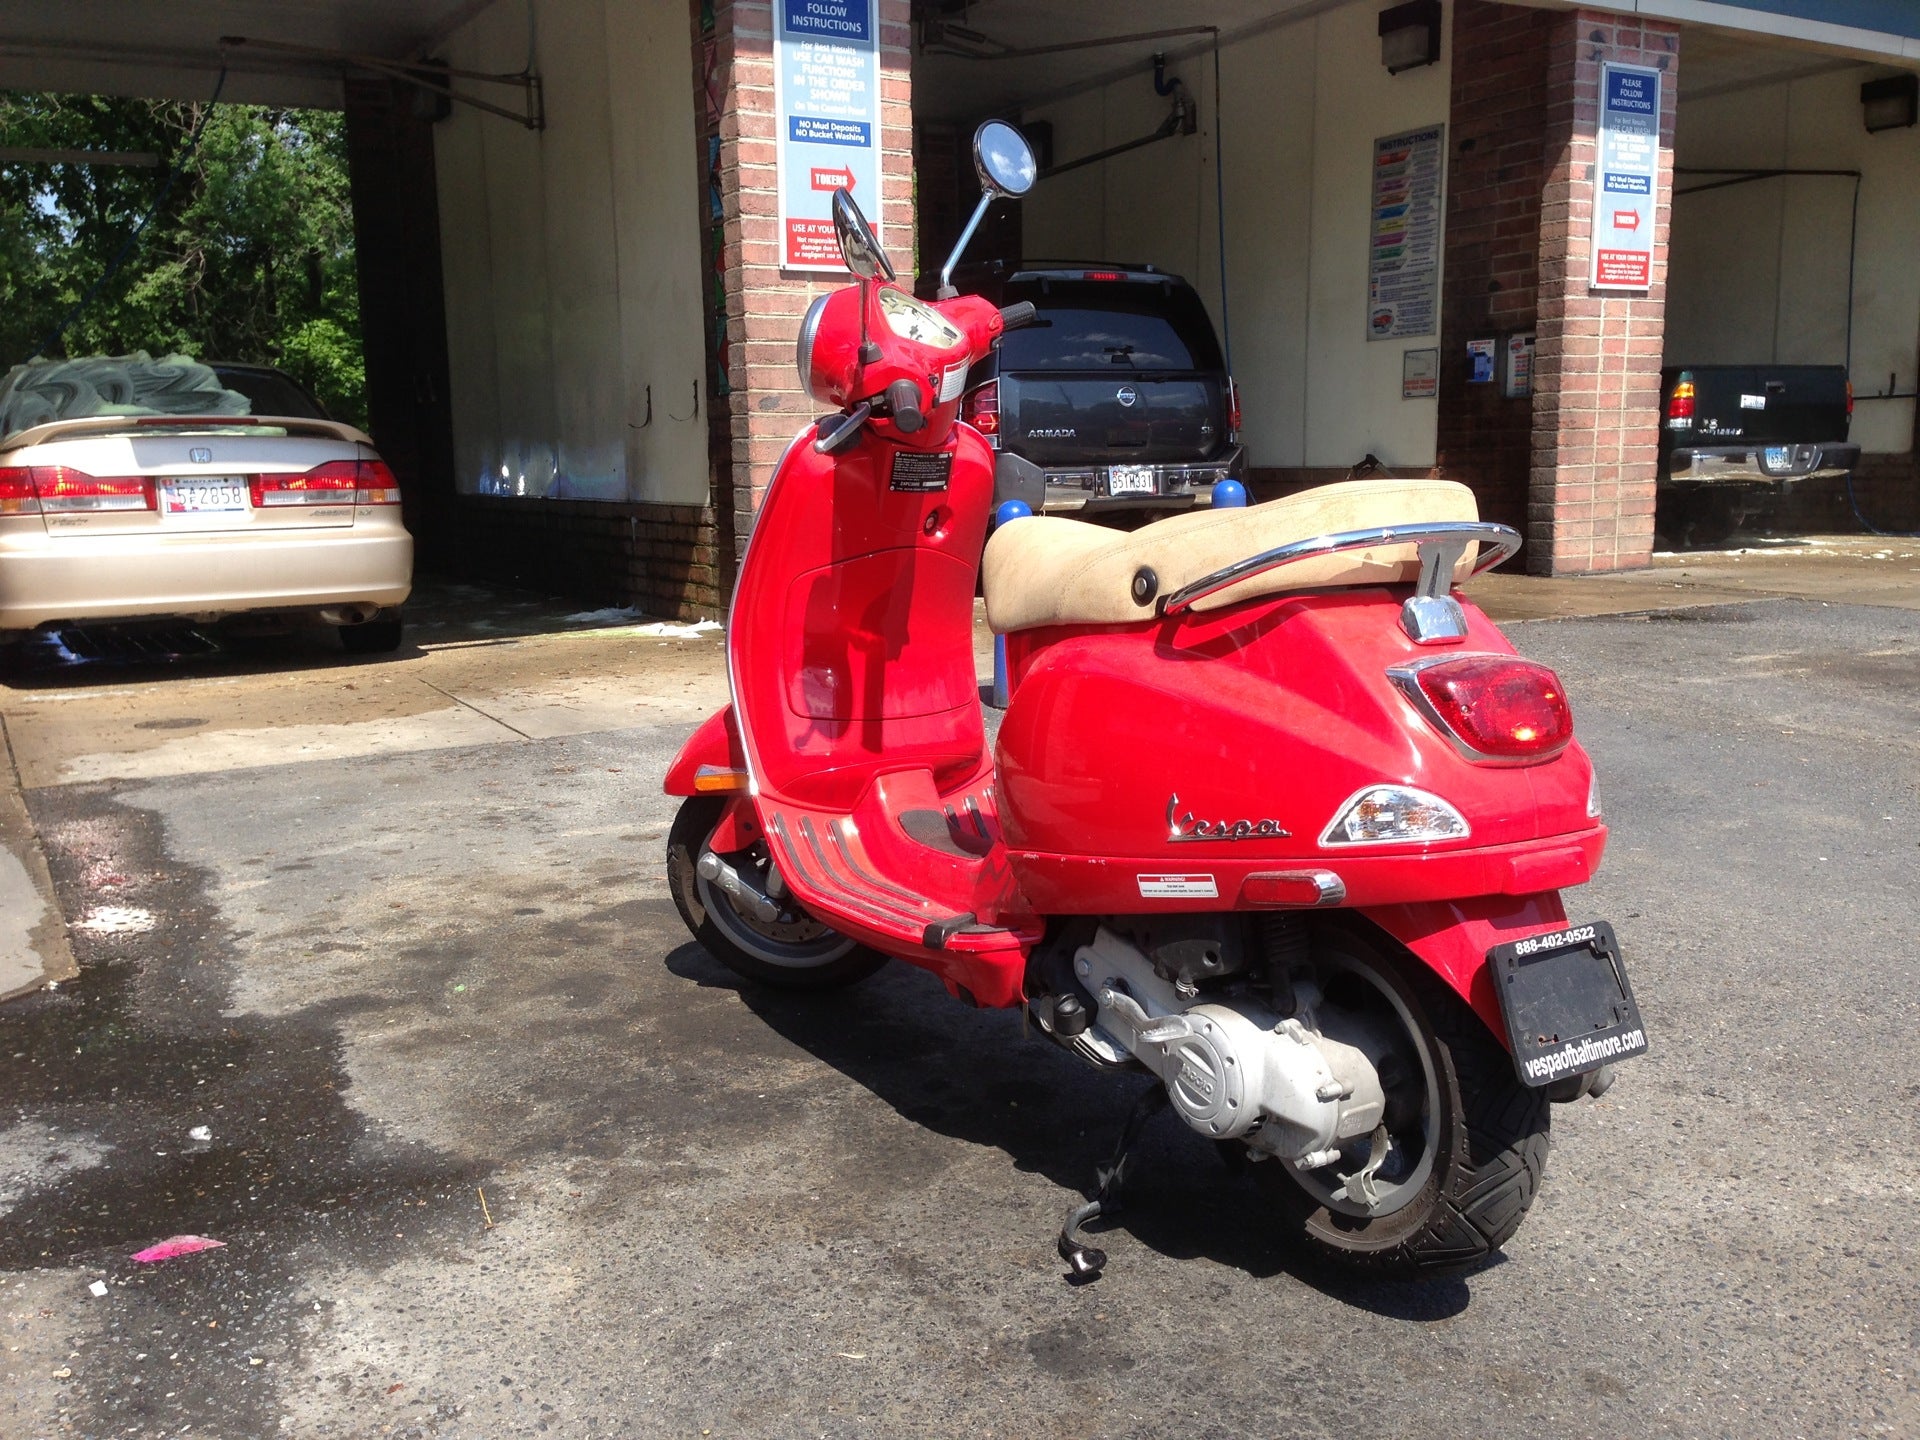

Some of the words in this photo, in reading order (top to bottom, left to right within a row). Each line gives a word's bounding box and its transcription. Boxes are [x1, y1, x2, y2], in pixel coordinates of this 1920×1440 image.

[807, 3, 847, 17] FOLLOW
[792, 15, 862, 33] INSTRUCTIONS
[794, 52, 812, 62] USE
[814, 53, 833, 64] CAR
[836, 56, 865, 68] WASH
[803, 64, 857, 78] FUNCTIONS
[793, 75, 805, 86] IN
[808, 76, 828, 89] THE
[831, 78, 865, 92] ORDER
[1622, 78, 1642, 88] PLEASE
[810, 88, 851, 102] SHOWN
[1620, 88, 1644, 98] FOLLOW
[1611, 98, 1651, 110] INSTRUCTIONS
[799, 120, 811, 128] NO
[812, 121, 829, 130] Mud
[831, 122, 861, 133] Deposits
[795, 128, 807, 136] NO
[809, 129, 834, 139] Bucket
[835, 132, 865, 144] Washing
[1379, 131, 1439, 151] INSTRUCTIONS
[815, 173, 848, 186] TOKENS
[792, 223, 806, 232] USE
[807, 224, 816, 233] AT
[1028, 428, 1076, 438] ARMADA
[1166, 792, 1292, 843] Vespa
[1515, 925, 1596, 956] 888-402-0522
[1525, 1029, 1645, 1079] vespaofbaltimore.com
